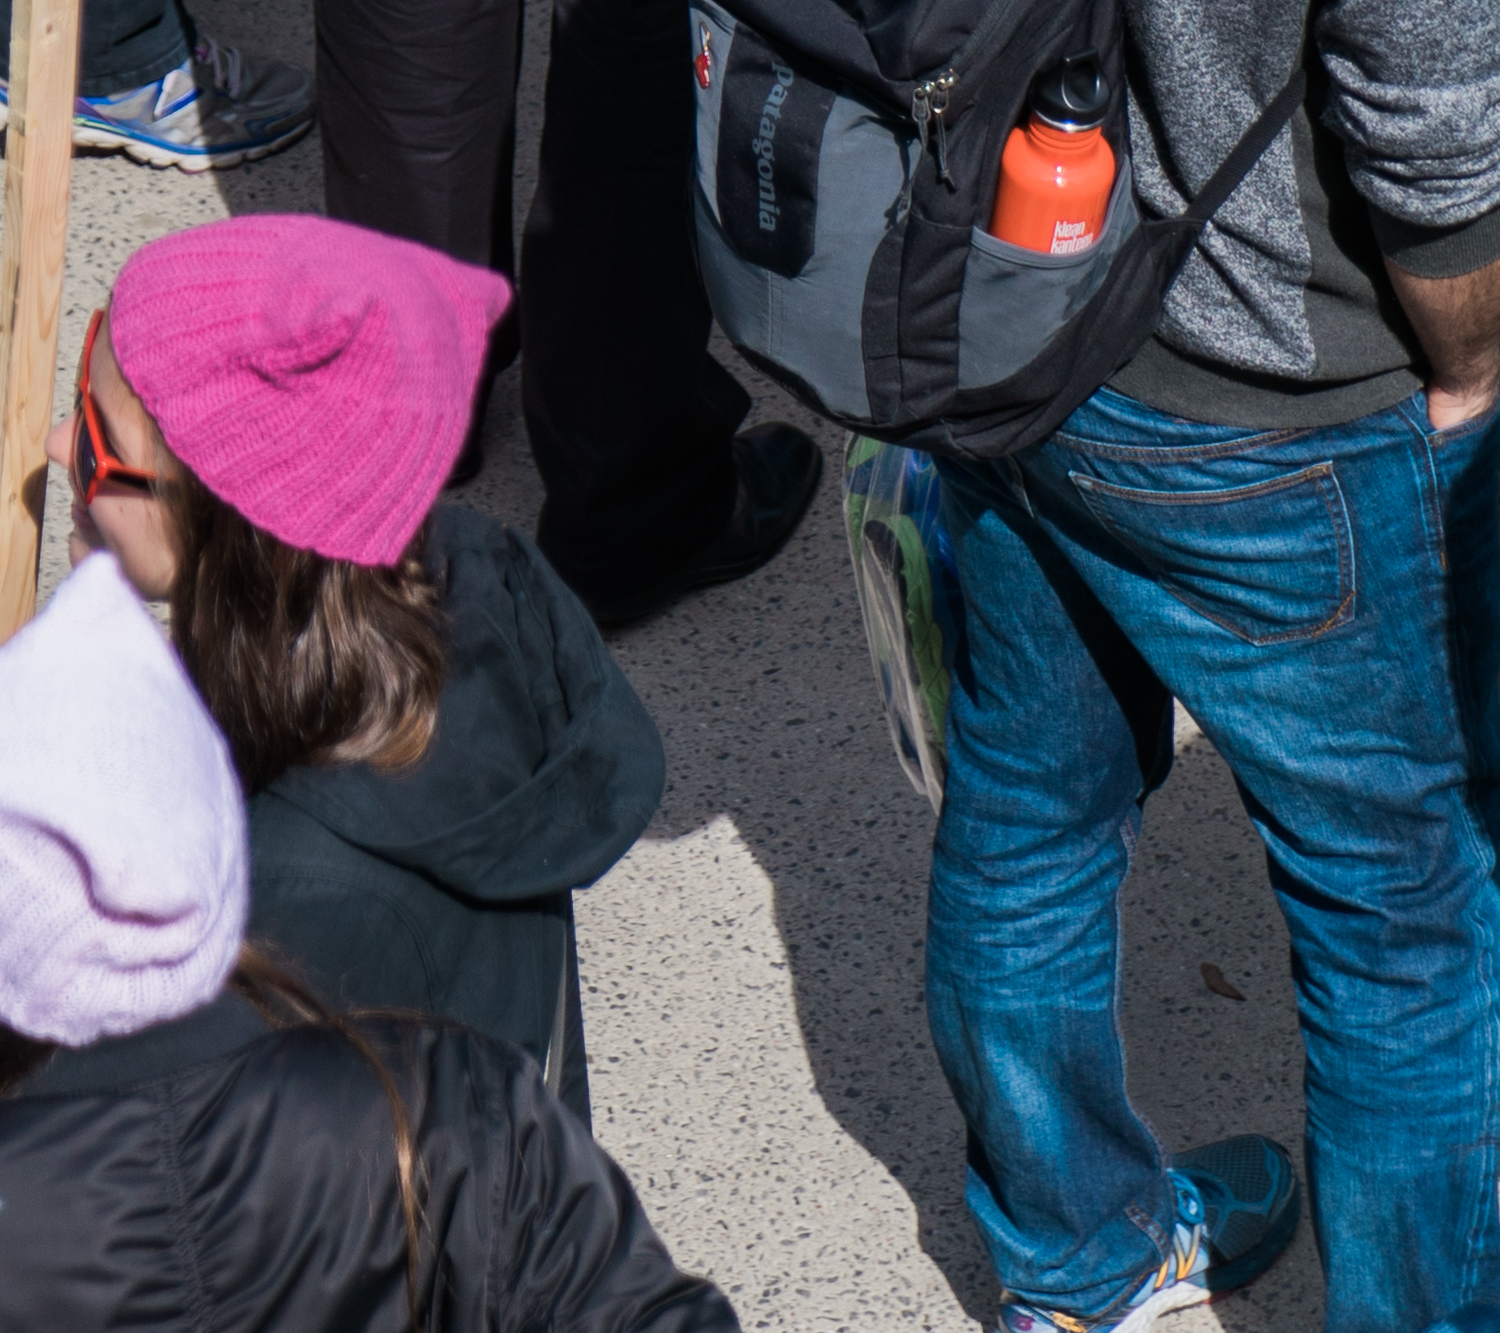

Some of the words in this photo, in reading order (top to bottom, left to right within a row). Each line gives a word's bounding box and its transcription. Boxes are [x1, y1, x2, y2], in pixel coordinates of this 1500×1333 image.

[754, 63, 793, 234] patagonia
[1054, 221, 1086, 237] klean
[1050, 233, 1094, 254] kanteen
